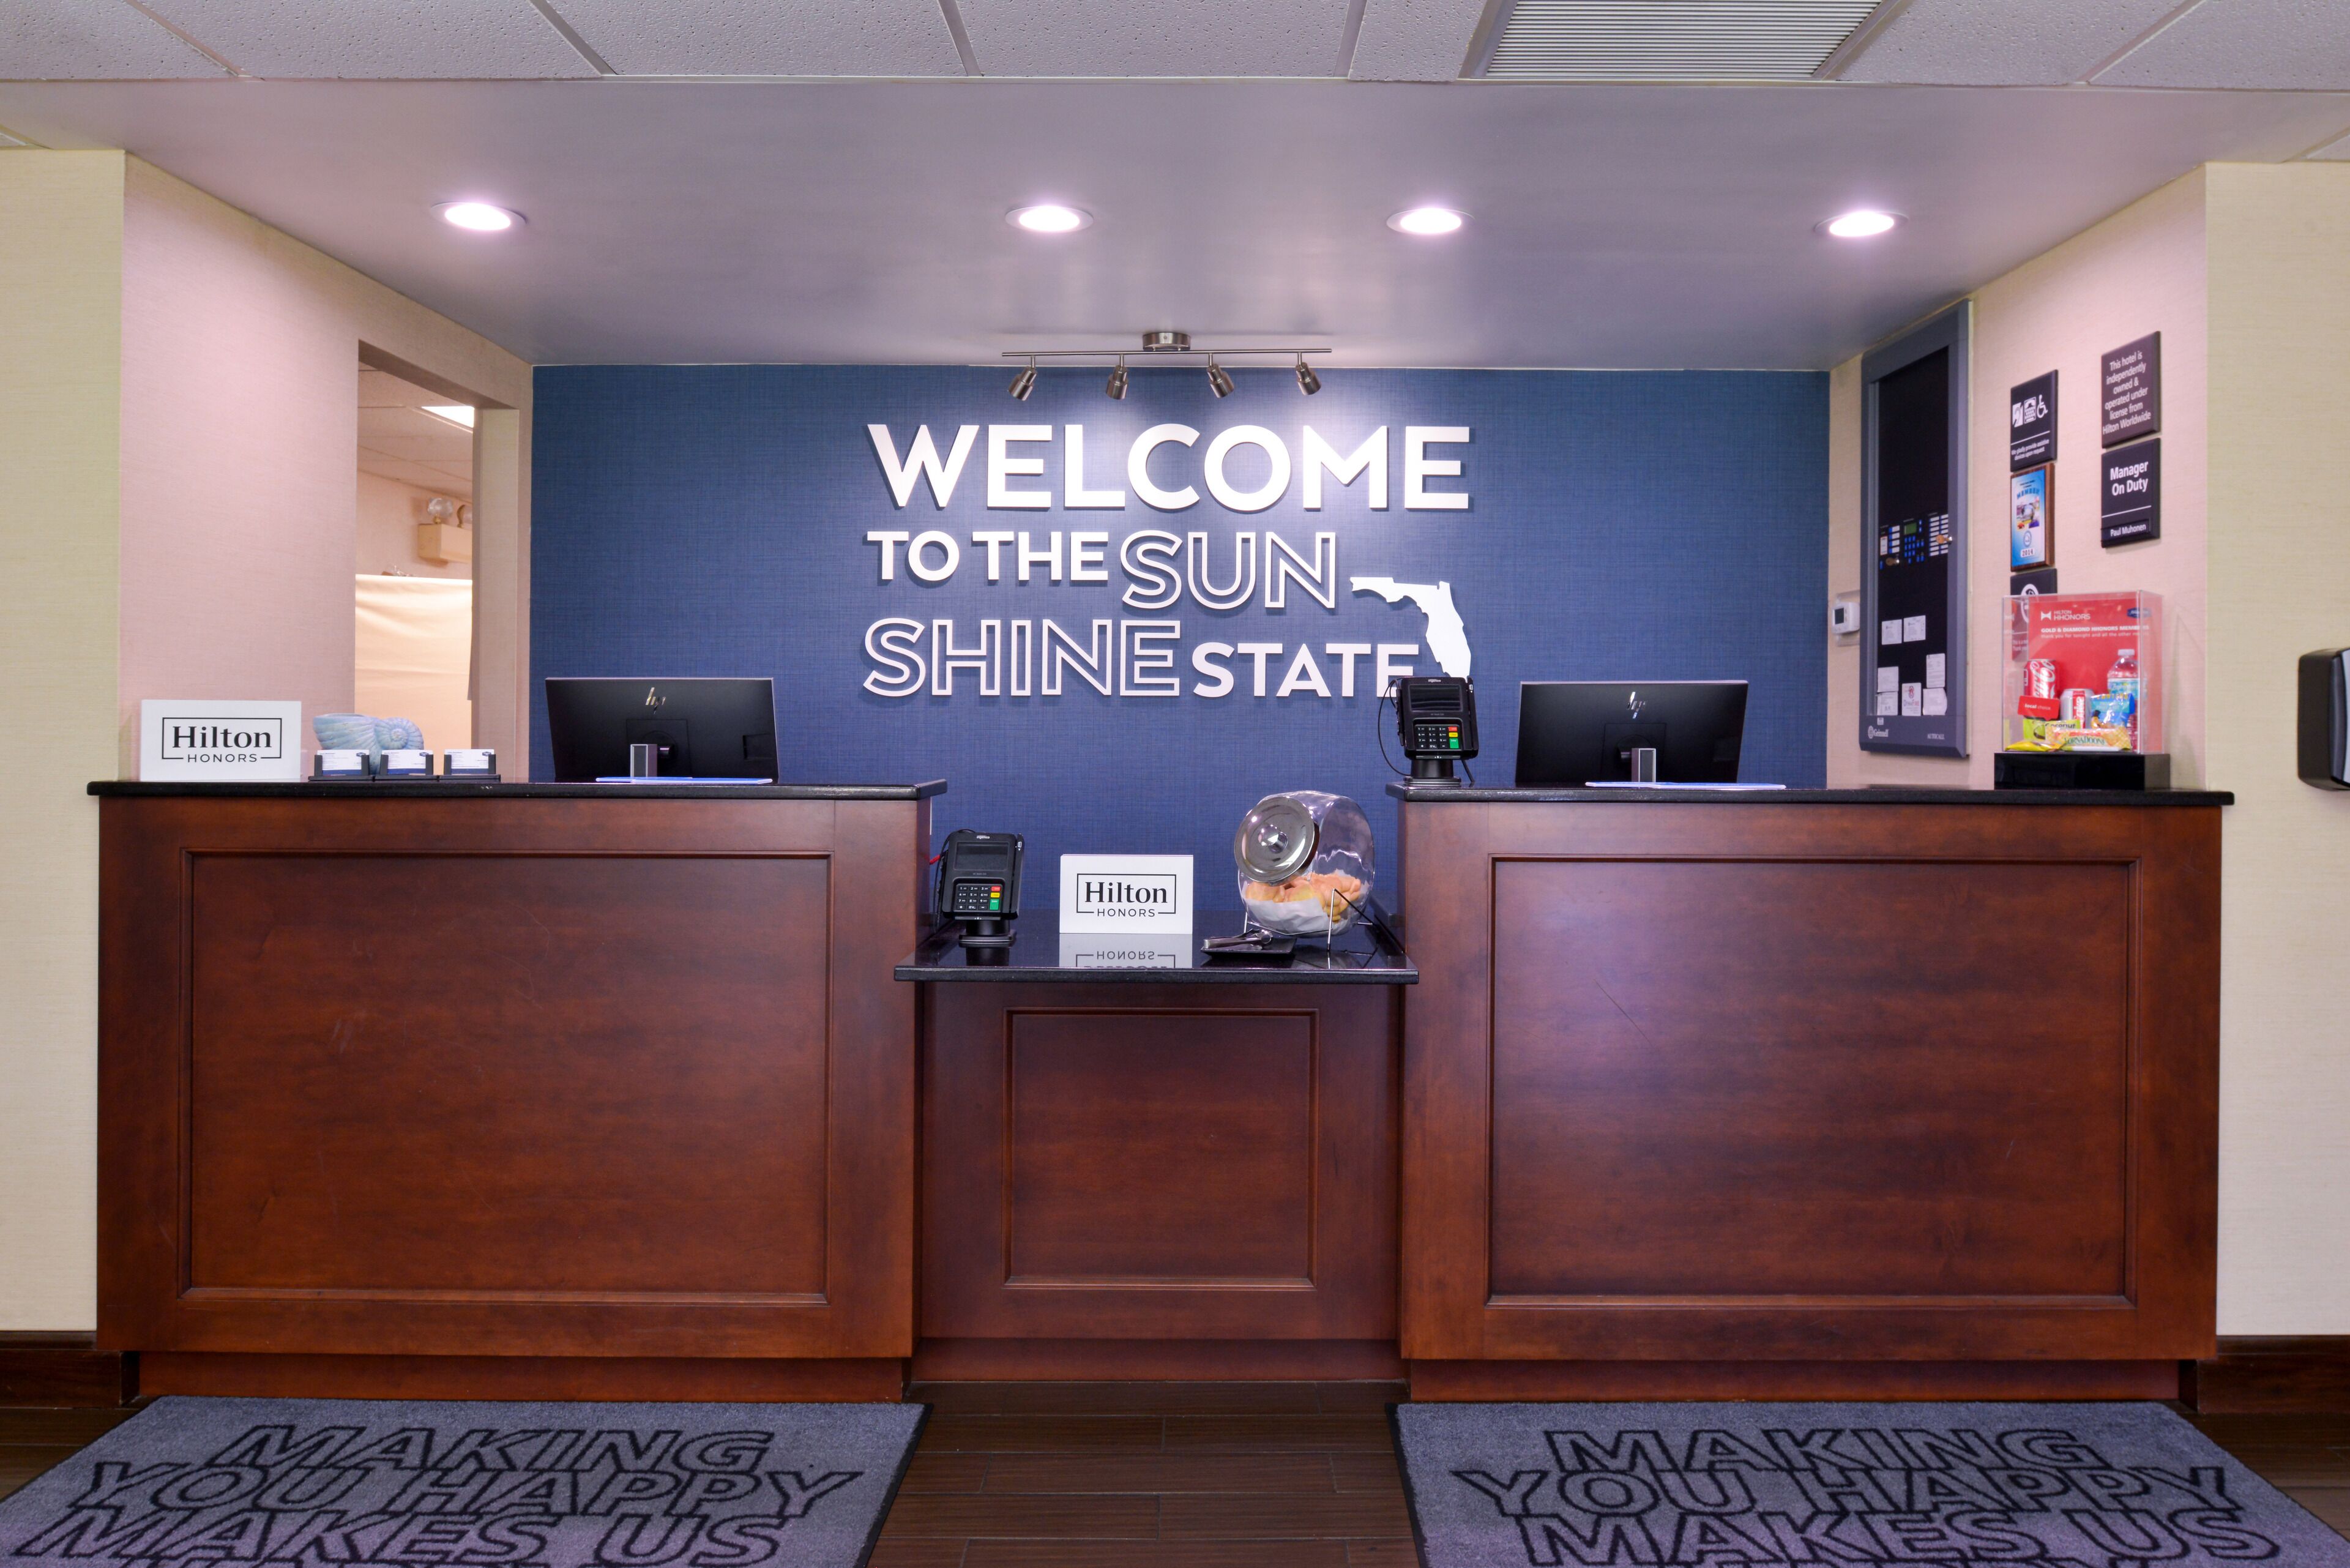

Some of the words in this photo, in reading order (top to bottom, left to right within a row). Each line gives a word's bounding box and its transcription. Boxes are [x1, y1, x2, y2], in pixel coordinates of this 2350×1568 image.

[2109, 359, 2121, 371] This
[2121, 352, 2136, 367] hotel
[2137, 350, 2143, 359] is
[2106, 362, 2146, 386] independently
[2113, 379, 2133, 394] owned
[2134, 376, 2139, 386] &
[2105, 392, 2130, 411] operated
[2130, 386, 2149, 400] under
[2109, 406, 2128, 420] license
[2128, 401, 2143, 413] from
[2102, 422, 2119, 435] Hilton
[2120, 411, 2152, 429] Worldwide
[867, 423, 1470, 512] WELCOME
[2109, 461, 2149, 480] Manager
[2017, 488, 2040, 499] MEMBER
[2112, 482, 2125, 496] On
[2127, 478, 2149, 493] Duty
[2110, 527, 2121, 537] Paul
[2122, 524, 2146, 534] Muhonen
[867, 530, 960, 581] TO
[972, 530, 1109, 581] THE
[1120, 530, 1336, 610] SUN
[864, 618, 1181, 697] SHINE
[1192, 642, 1419, 698] STATE
[172, 726, 272, 749] Hilton
[187, 753, 258, 763] HONORS
[1085, 881, 1168, 903] Hilton
[1097, 908, 1155, 917] HONORS
[208, 1425, 774, 1473] MAKING
[1544, 1428, 2114, 1472] MAKING
[69, 1460, 374, 1513] YOU
[382, 1467, 864, 1518] HAPPY
[1449, 1469, 1758, 1517] YOU
[1785, 1466, 2244, 1514] HAPPY
[10, 1504, 563, 1564] MAKES
[592, 1514, 788, 1567] US
[1515, 1509, 2050, 1566] MAKES
[2061, 1508, 2282, 1561] US
